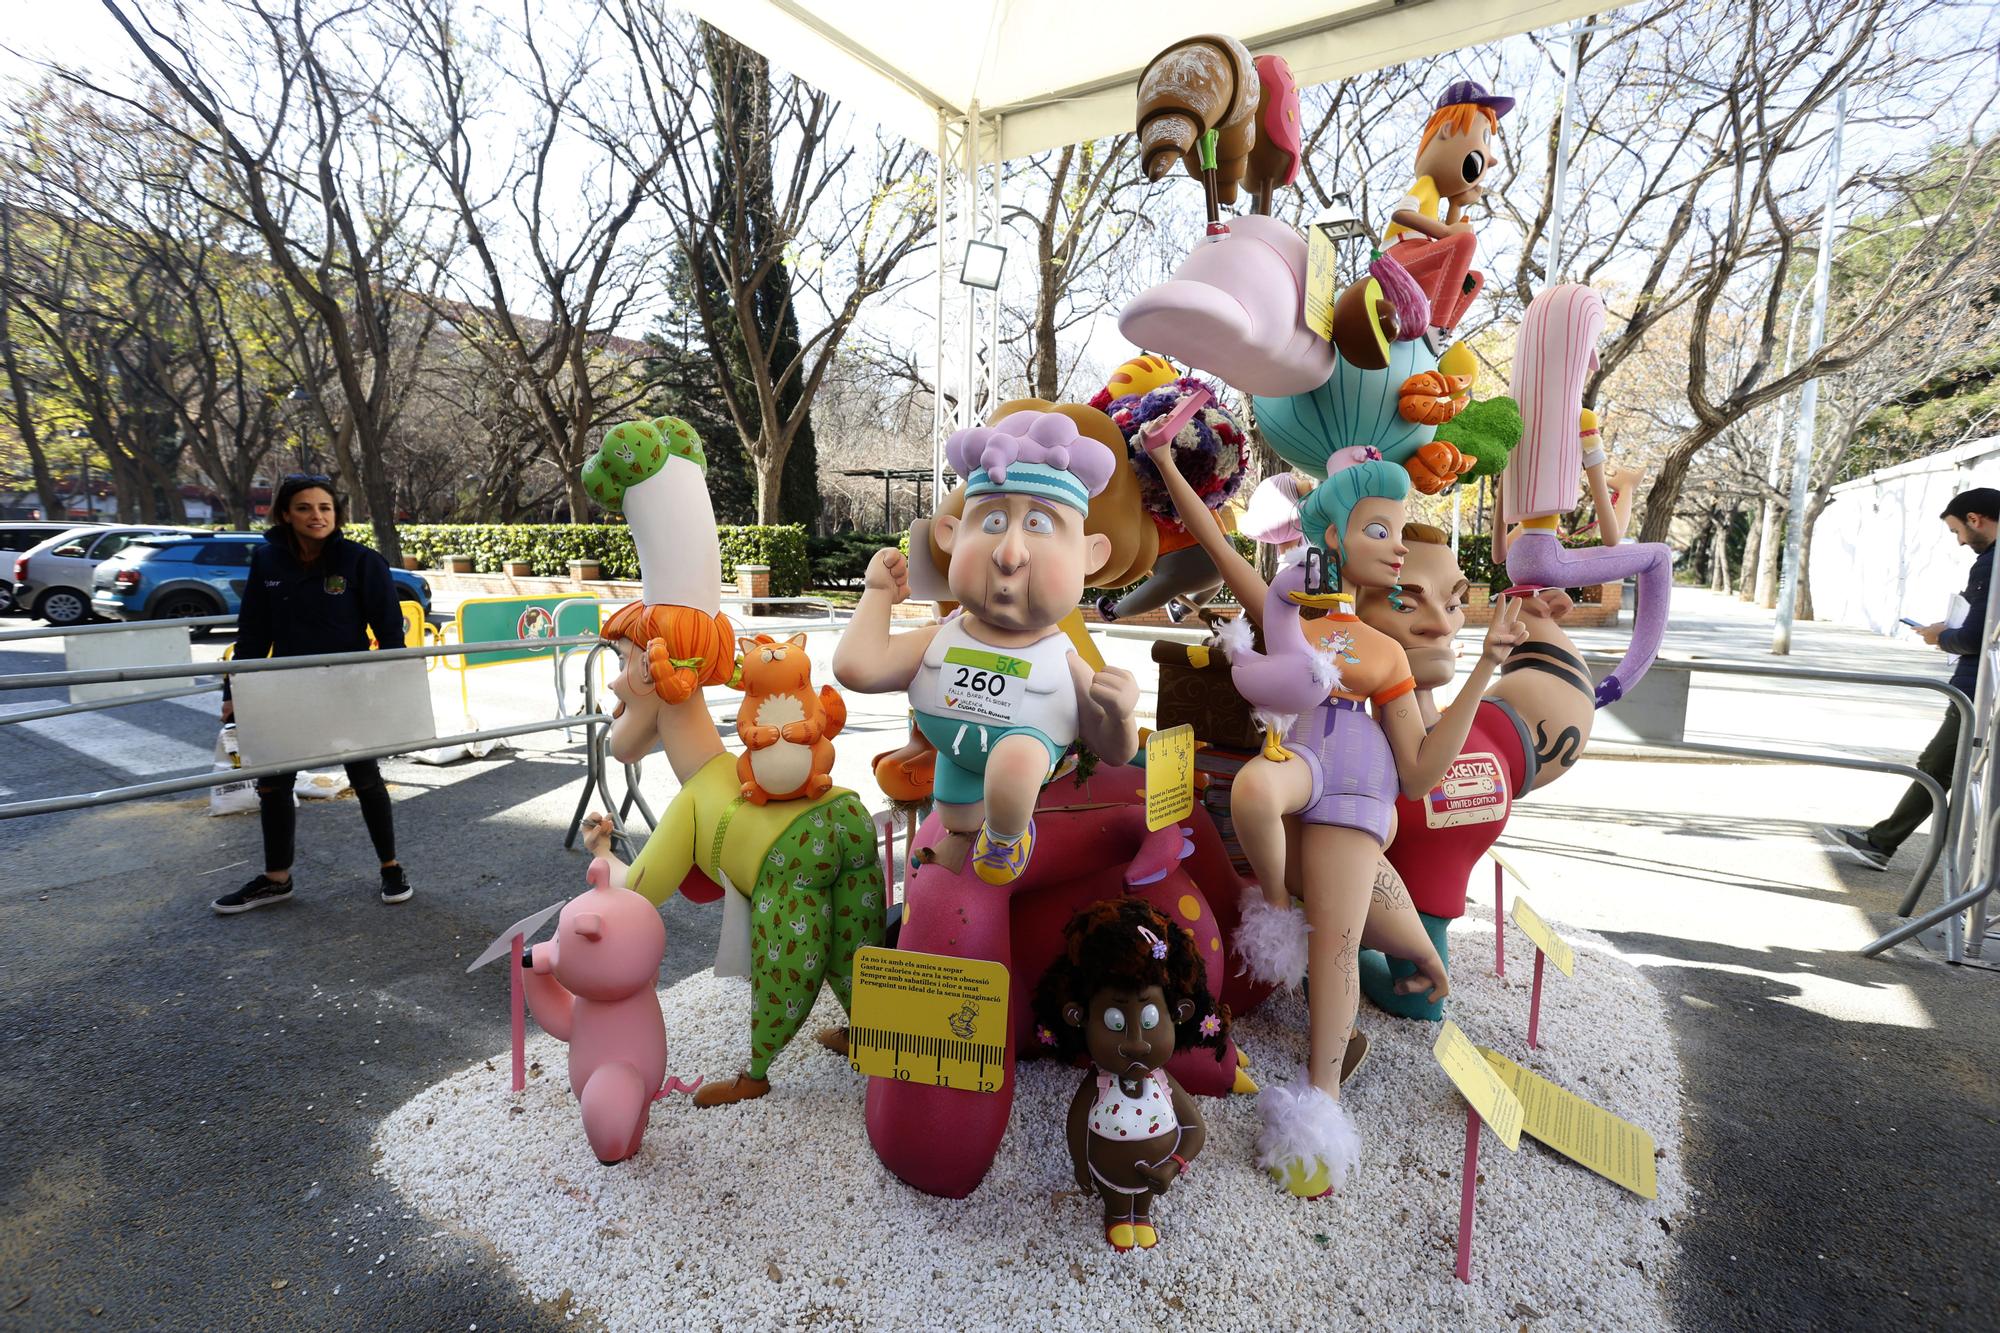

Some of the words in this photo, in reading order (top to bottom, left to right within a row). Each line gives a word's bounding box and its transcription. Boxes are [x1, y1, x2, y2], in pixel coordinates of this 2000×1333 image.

[996, 656, 1022, 675] 5K
[954, 668, 1005, 696] 260
[1443, 763, 1496, 779] CKENZIE
[1446, 799, 1472, 809] LIMITED
[1473, 797, 1496, 805] EDITION
[860, 971, 886, 980] Sempre
[904, 977, 936, 986] sabatilles
[861, 963, 883, 971] Gastar
[885, 966, 911, 975] calories
[959, 976, 989, 985] obsessió
[860, 978, 896, 989] Perseguint
[962, 992, 1001, 1003] imaginació
[892, 1068, 910, 1081] 10
[936, 1075, 950, 1087] 11
[976, 1081, 994, 1093] 12
